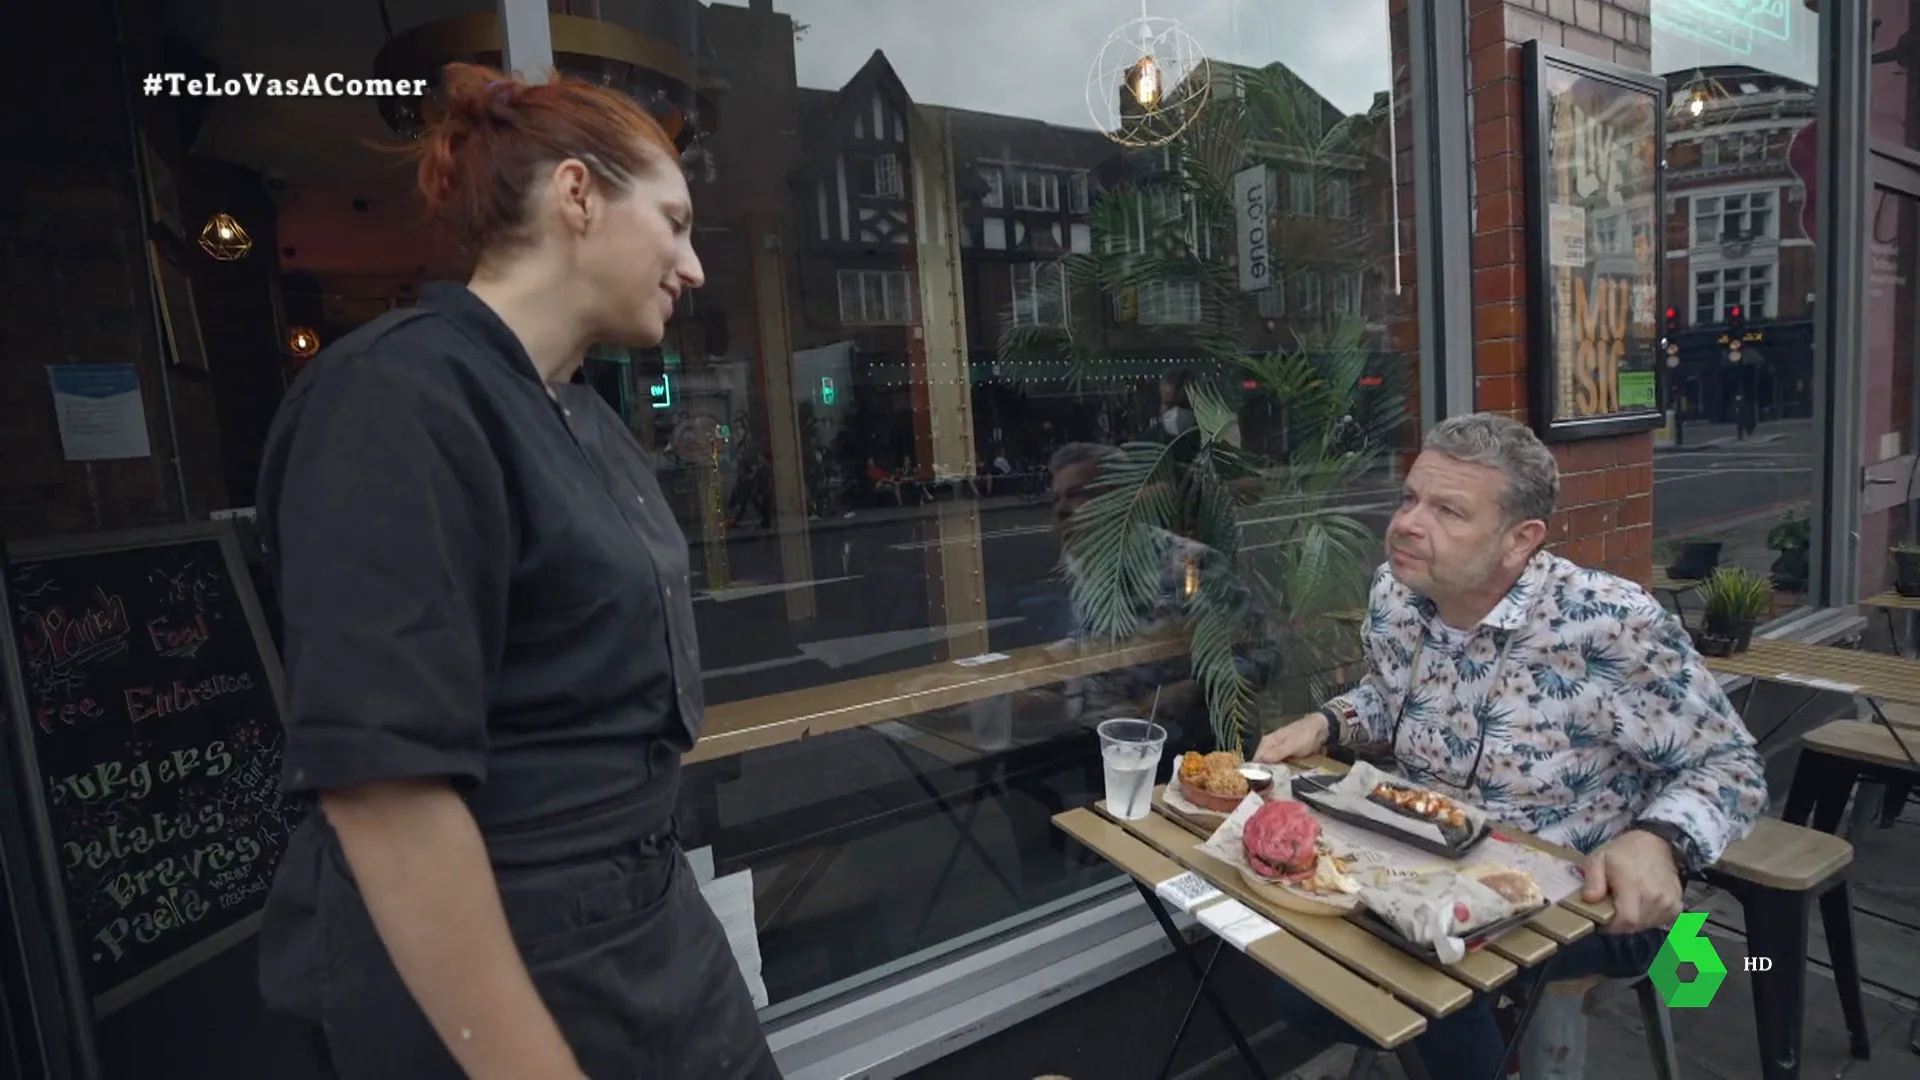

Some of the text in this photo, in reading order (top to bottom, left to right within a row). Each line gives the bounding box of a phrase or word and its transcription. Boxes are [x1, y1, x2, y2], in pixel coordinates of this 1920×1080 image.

[1575, 276, 1630, 342] MU
[123, 672, 256, 724] Entrance
[103, 836, 262, 909] Bravas
[94, 886, 210, 963] Paella
